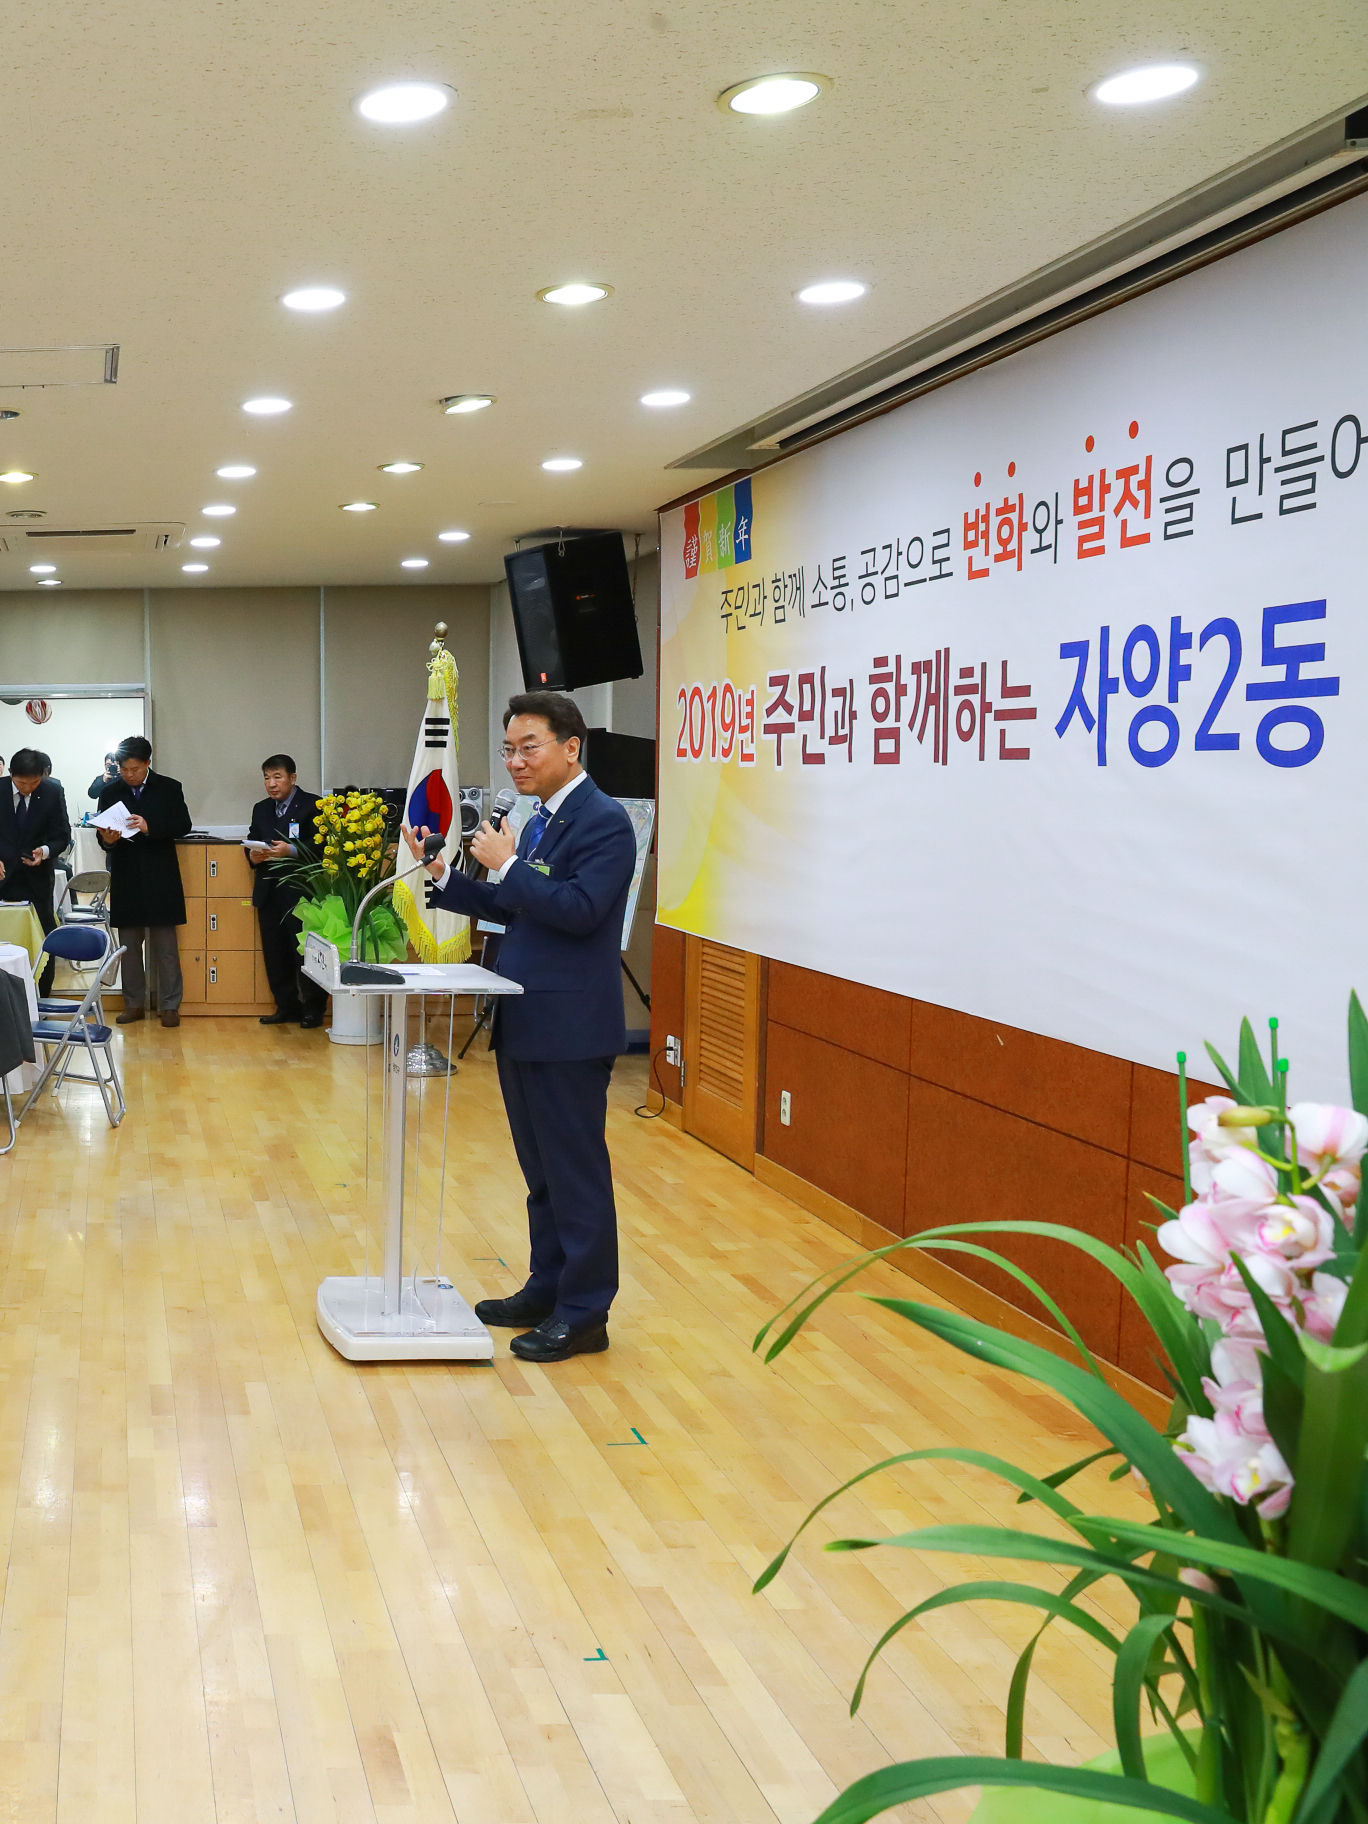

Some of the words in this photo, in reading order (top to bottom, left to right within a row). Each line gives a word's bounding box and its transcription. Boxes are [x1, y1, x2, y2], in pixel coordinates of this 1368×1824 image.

[720, 577, 767, 634] 주민과
[771, 565, 806, 624] 함께
[963, 492, 1064, 581] 변화와
[1073, 454, 1201, 560] 발전을
[676, 682, 755, 763] 2019년
[763, 665, 858, 767] 주민과
[868, 647, 1037, 766] 함께하는
[1054, 598, 1340, 768] 자양2동
